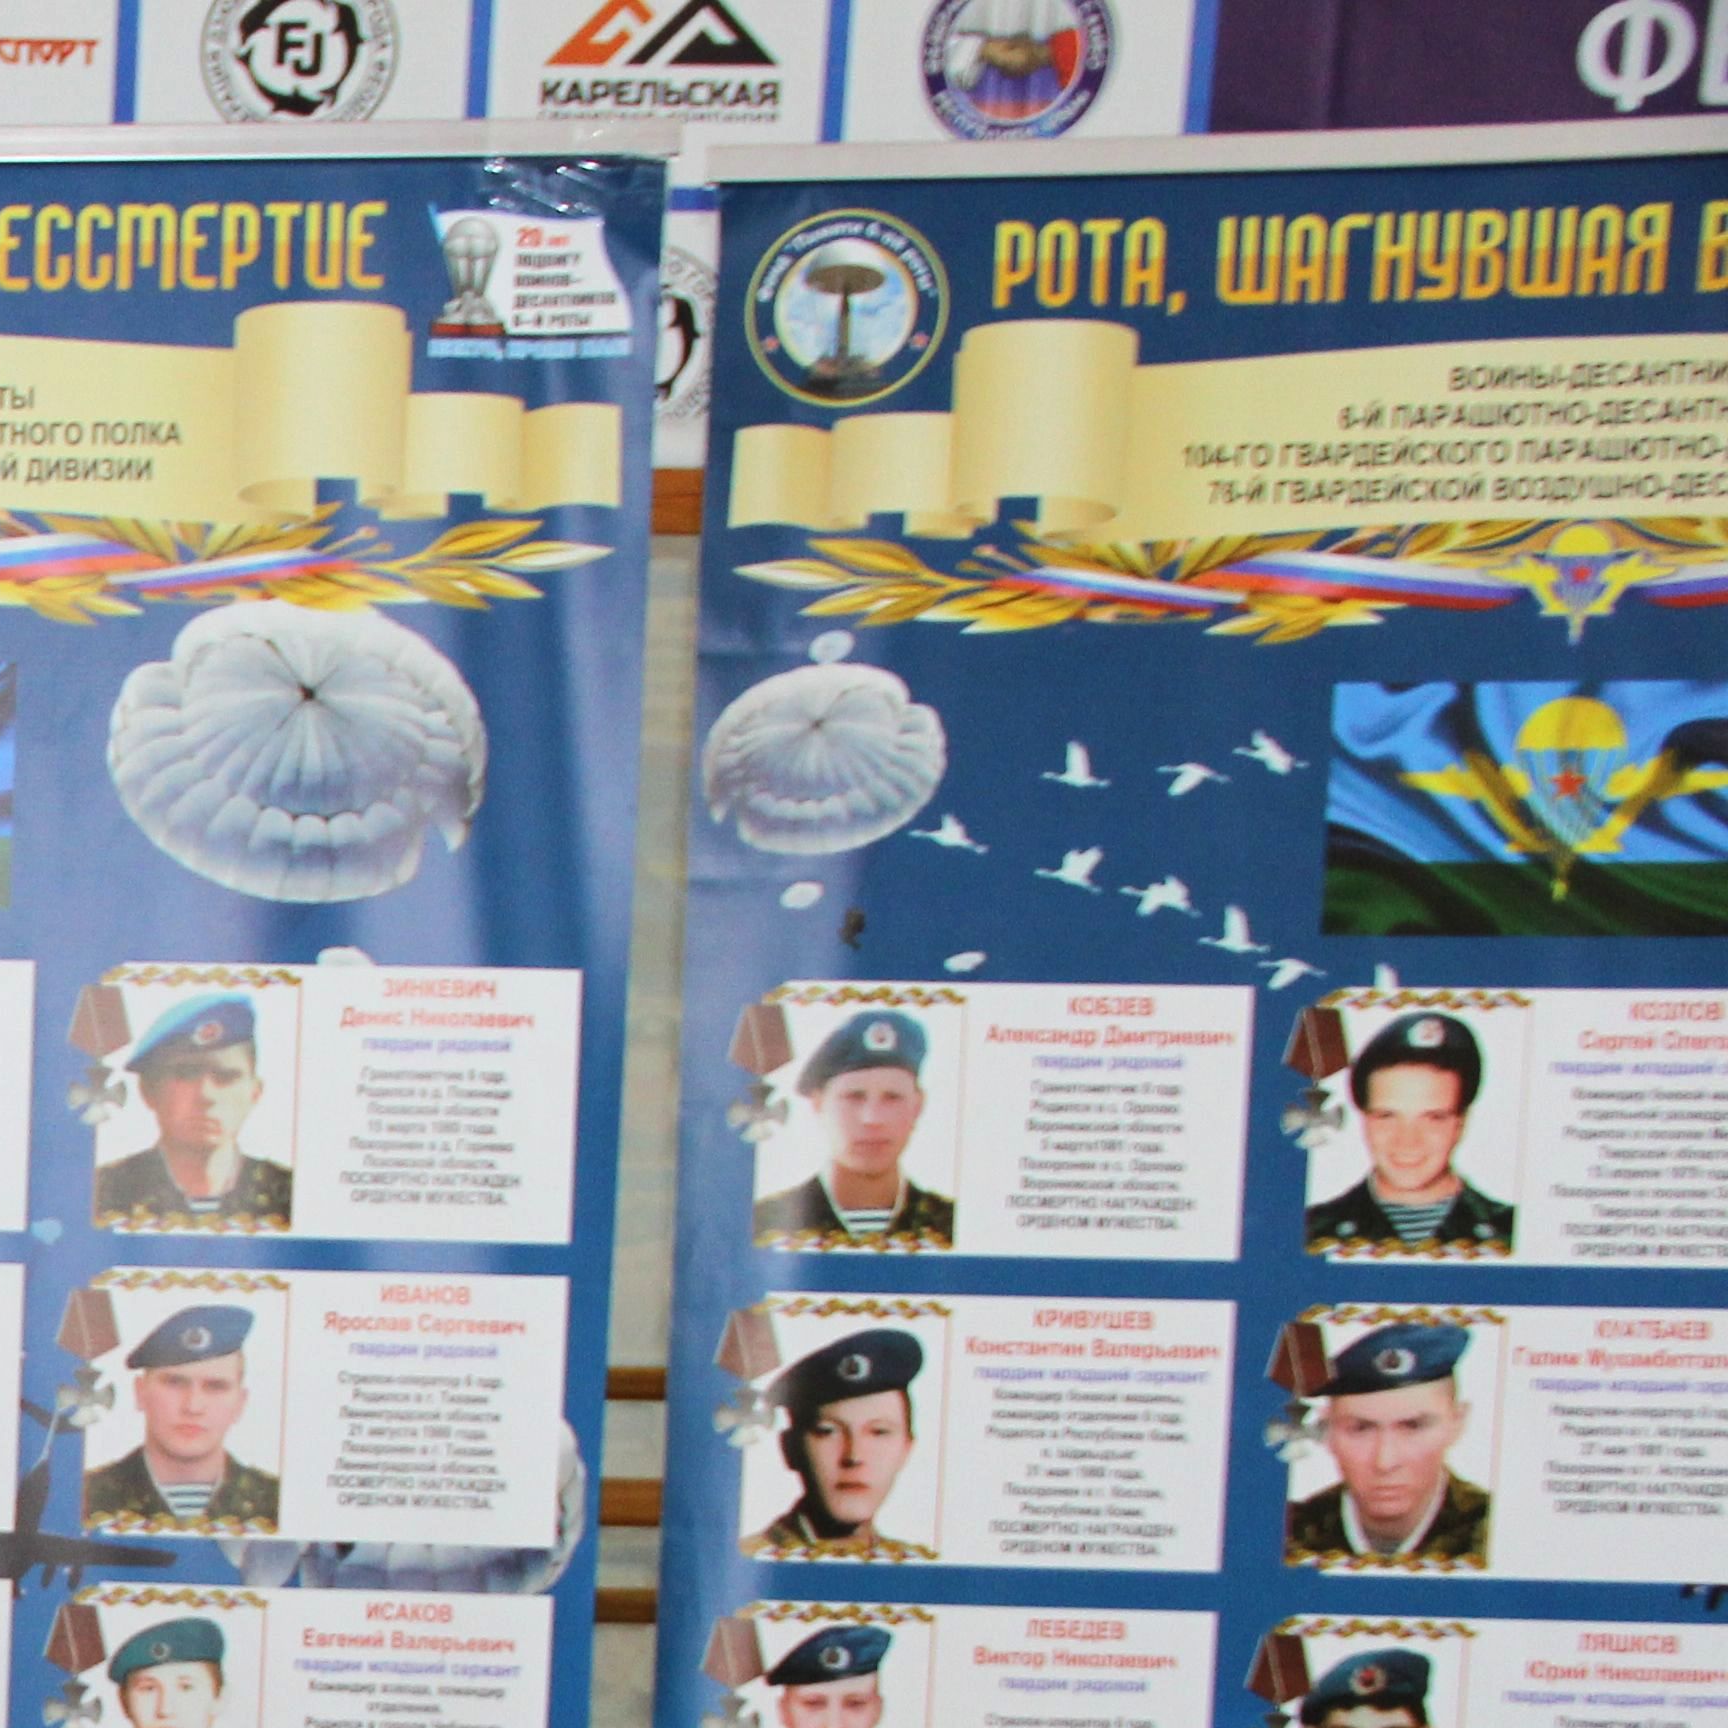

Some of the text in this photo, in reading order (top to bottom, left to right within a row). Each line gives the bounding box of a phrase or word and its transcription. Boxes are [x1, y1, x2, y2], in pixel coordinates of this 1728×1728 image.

[538, 78, 780, 108] КАРЕЛЬСКАЯ
[993, 216, 1187, 313] РОТА,
[1216, 202, 1673, 305] ШАГНУВШАЯ
[91, 421, 181, 447] ПОЛКА
[24, 457, 153, 485] ДИВИЗИИ
